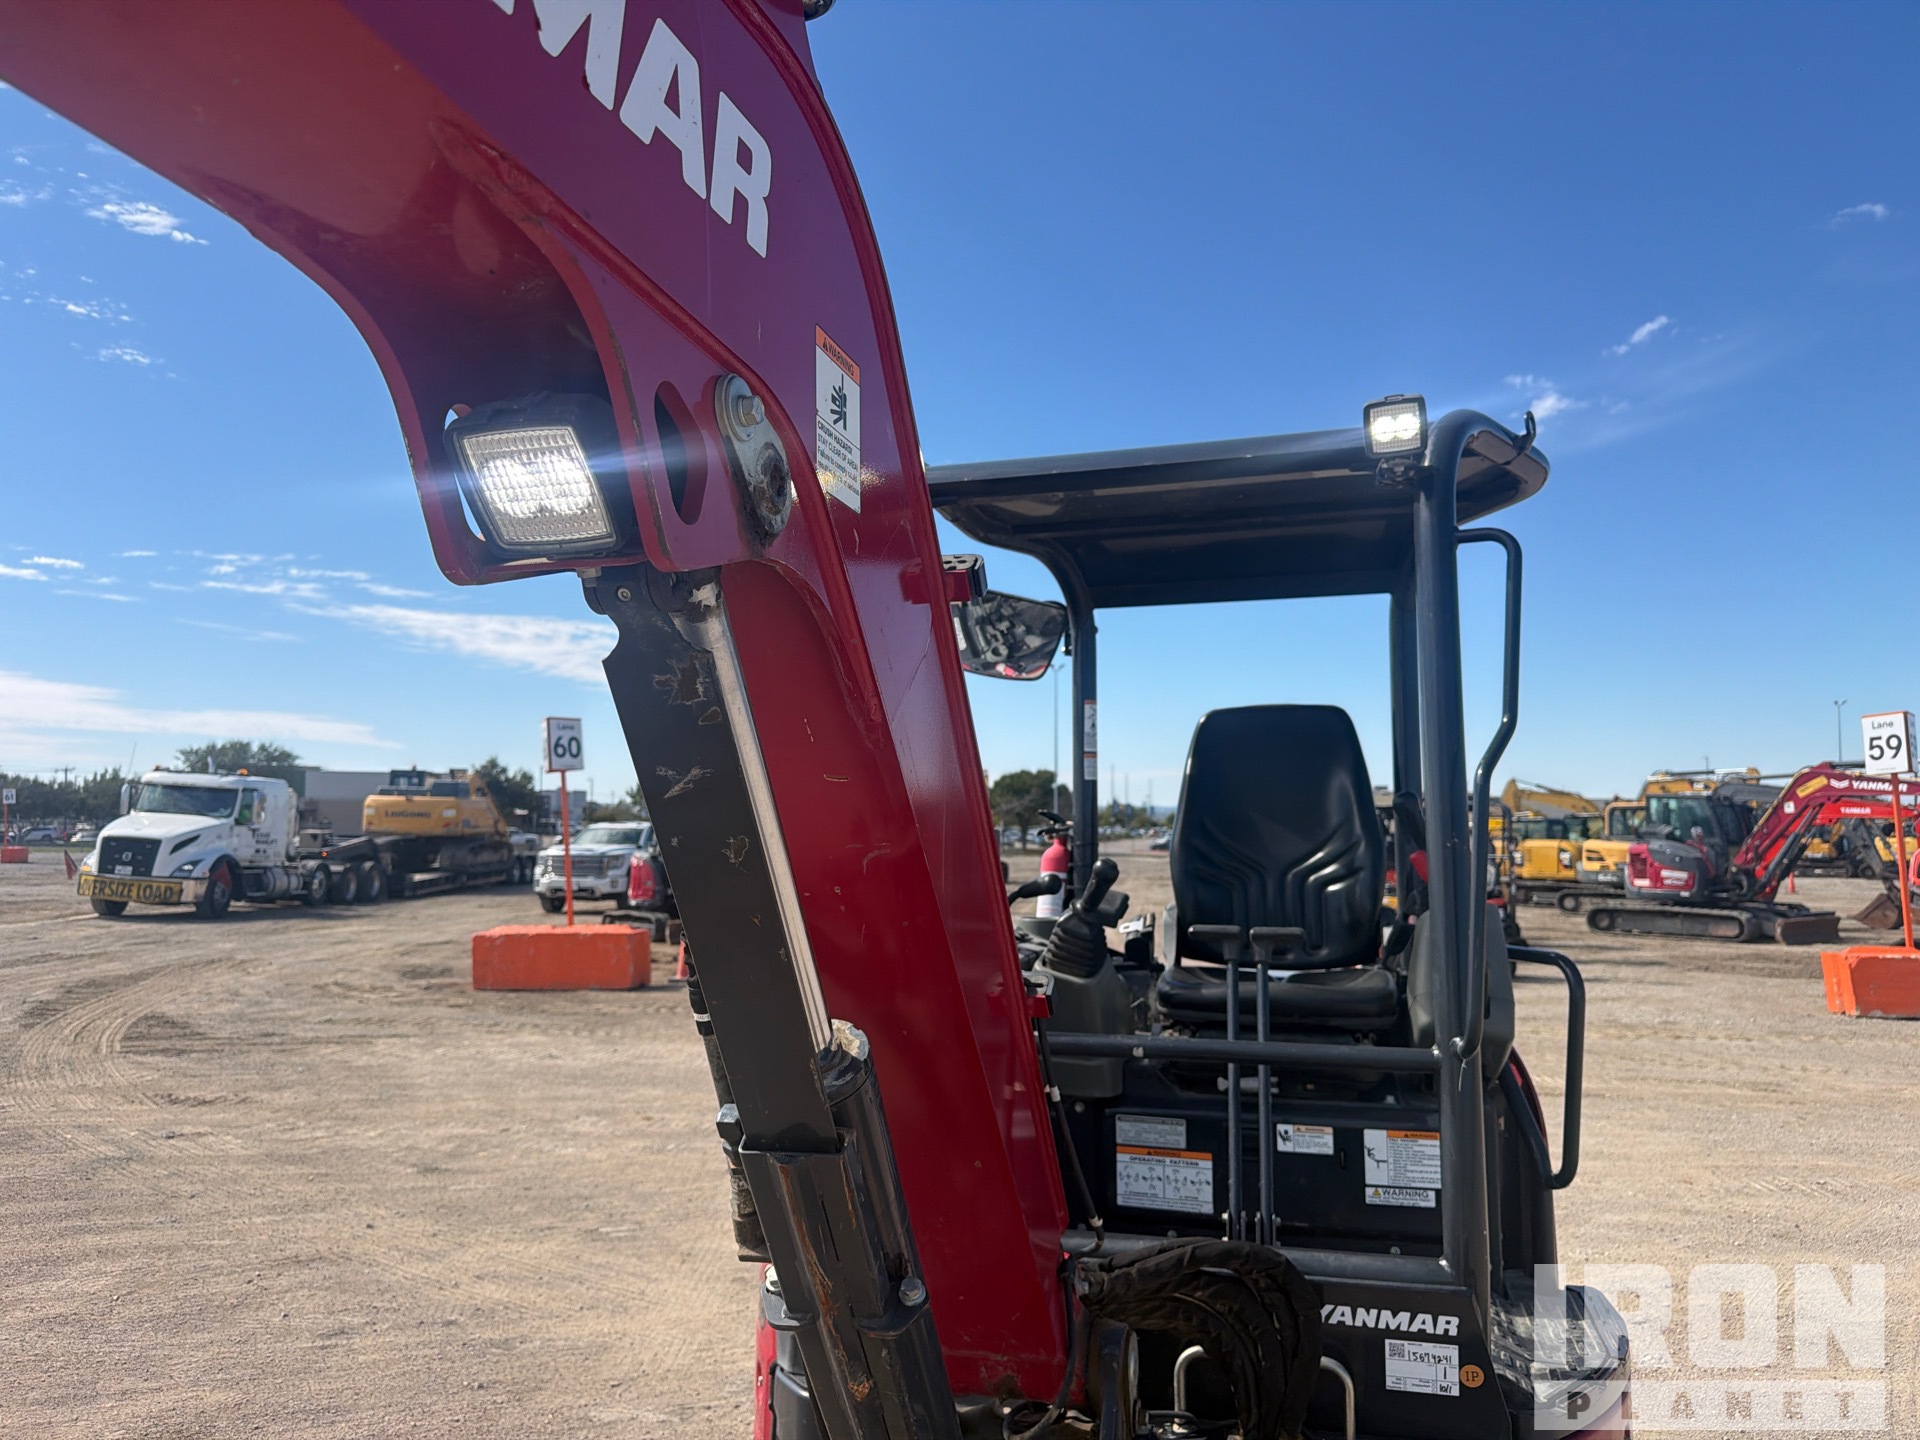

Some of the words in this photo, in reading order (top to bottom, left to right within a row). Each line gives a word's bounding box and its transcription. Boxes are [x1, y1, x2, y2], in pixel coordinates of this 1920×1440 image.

[1871, 720, 1894, 730] Lane
[553, 735, 582, 759] 60
[1868, 733, 1903, 761] 59
[81, 878, 134, 899] OVERSIZE
[136, 884, 174, 901] LOAD
[1382, 1188, 1430, 1199] WARNING
[1320, 1303, 1460, 1336] YANMAR
[1465, 1370, 1479, 1382] IP
